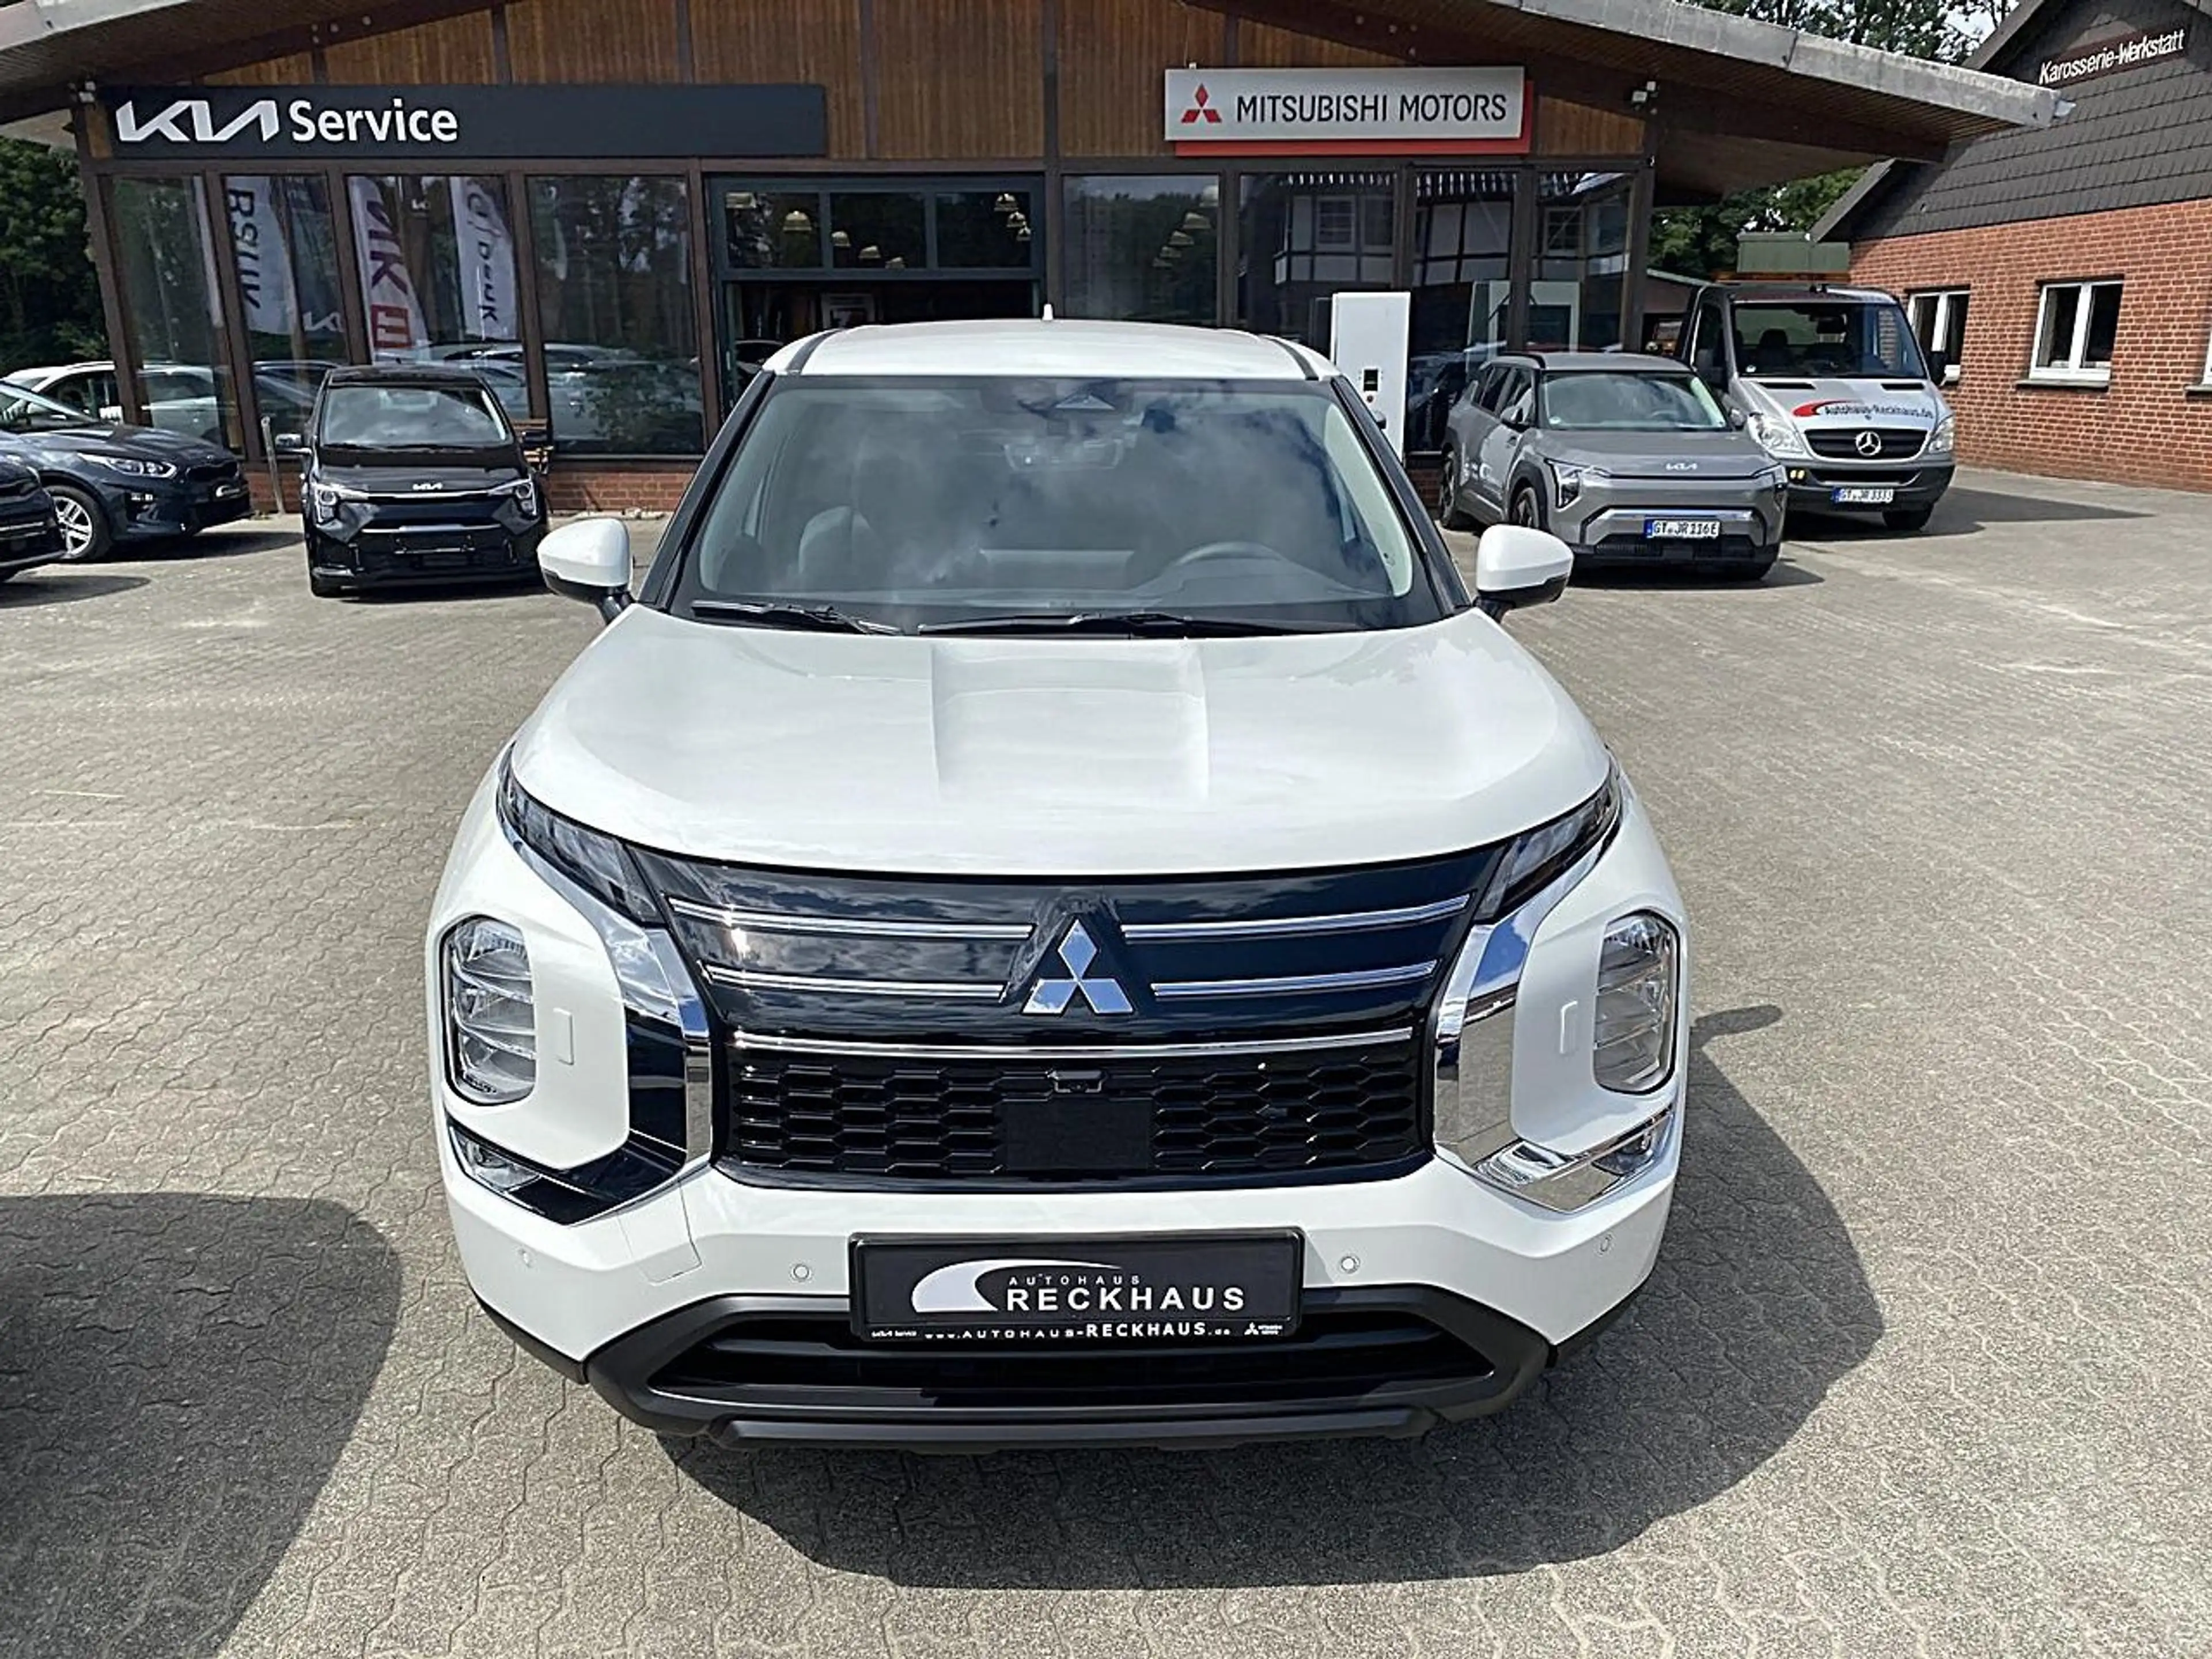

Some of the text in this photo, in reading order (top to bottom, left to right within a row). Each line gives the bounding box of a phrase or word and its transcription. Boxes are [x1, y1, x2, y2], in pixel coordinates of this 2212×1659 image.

[2039, 29, 2185, 85] Karosserie-Werkstatt
[115, 98, 459, 142] KIA Service
[1236, 94, 1507, 123] MITSUBISHI MOTORS
[1009, 1274, 1140, 1286] AUTOHAUS
[1007, 1287, 1245, 1312] RECKHAUS
